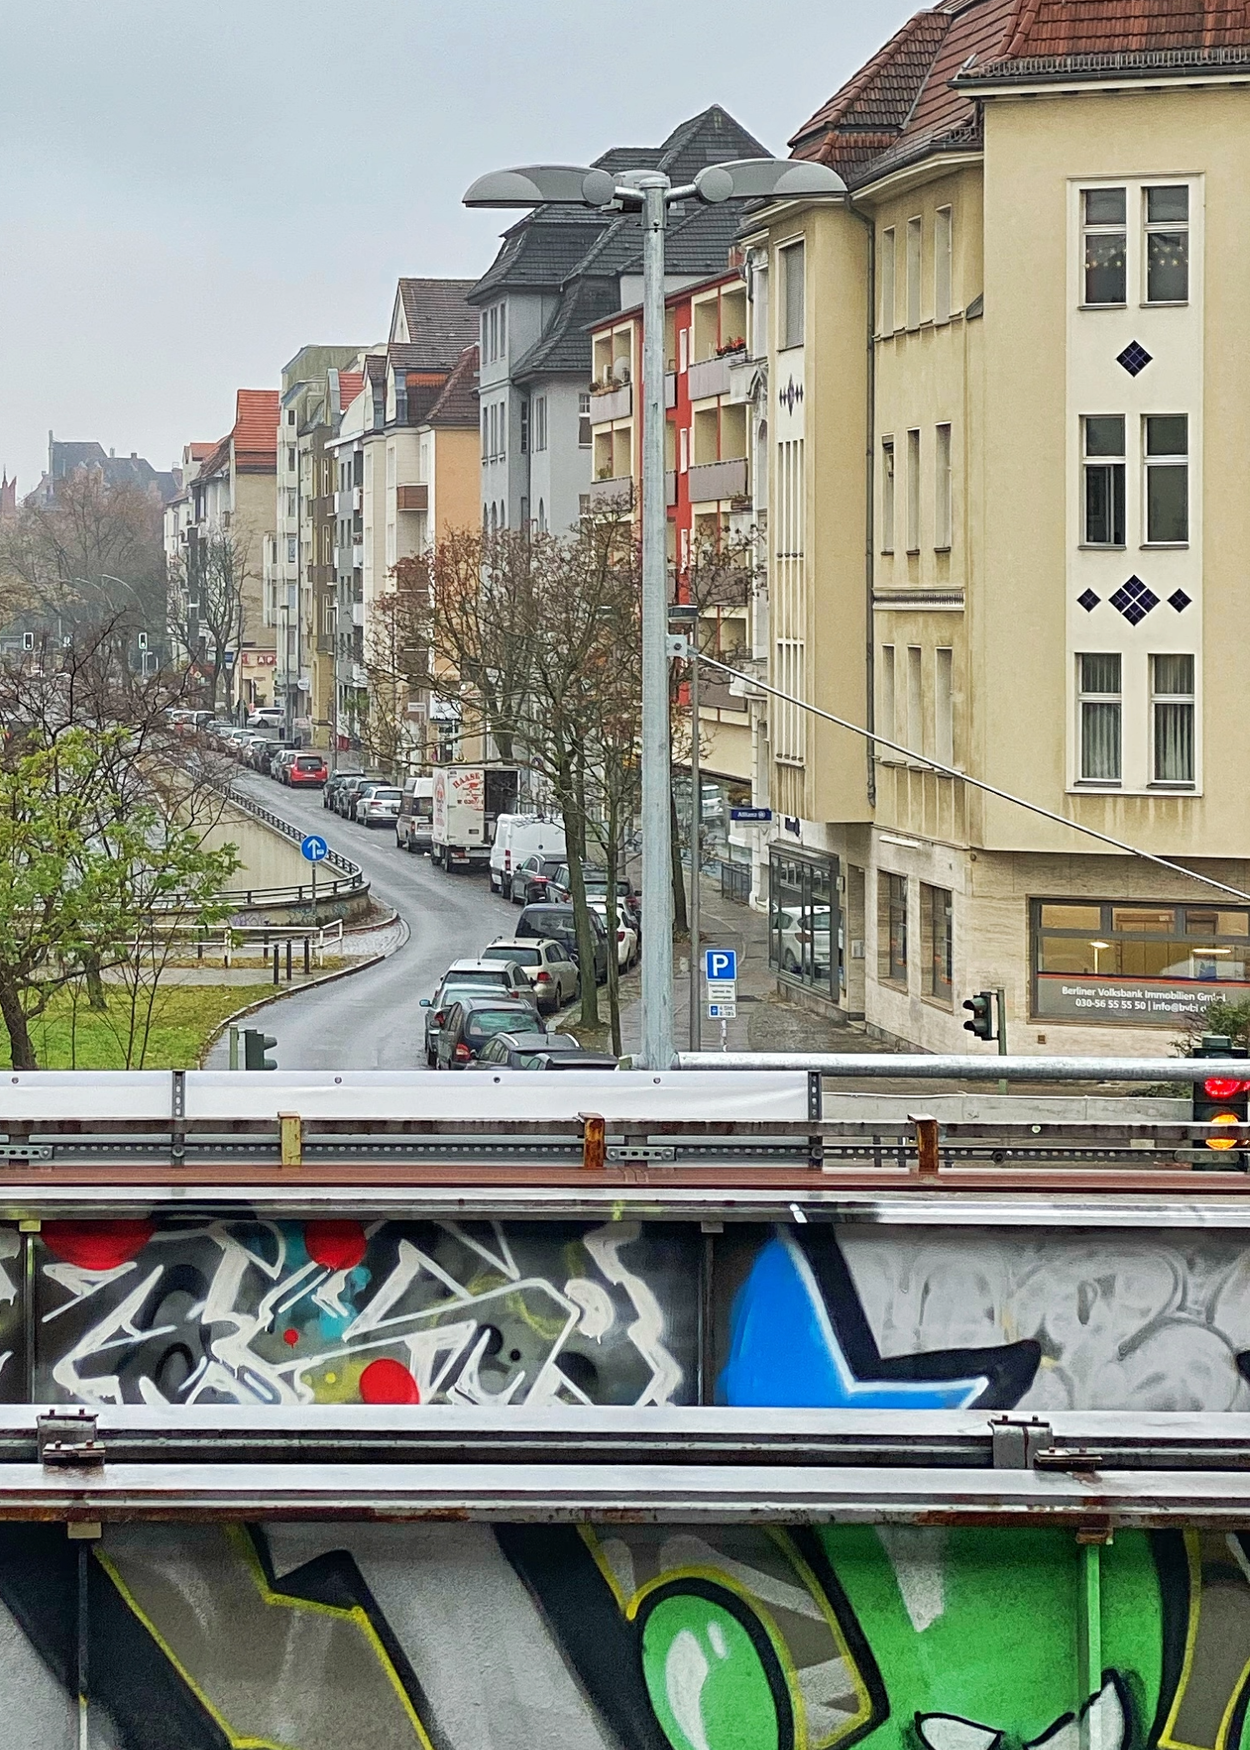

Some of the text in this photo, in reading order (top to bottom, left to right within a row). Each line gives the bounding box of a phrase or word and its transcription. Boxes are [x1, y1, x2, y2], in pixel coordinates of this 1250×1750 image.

[452, 772, 480, 789] HAASE
[712, 953, 729, 977] P
[1062, 986, 1096, 996] Berliner
[1097, 987, 1143, 998] Volksbank
[1144, 990, 1196, 1001] Immobilien
[1075, 998, 1106, 1008] 030-56
[1107, 999, 1119, 1009] 55
[1121, 1000, 1133, 1009] 55
[1134, 1001, 1146, 1010] 50
